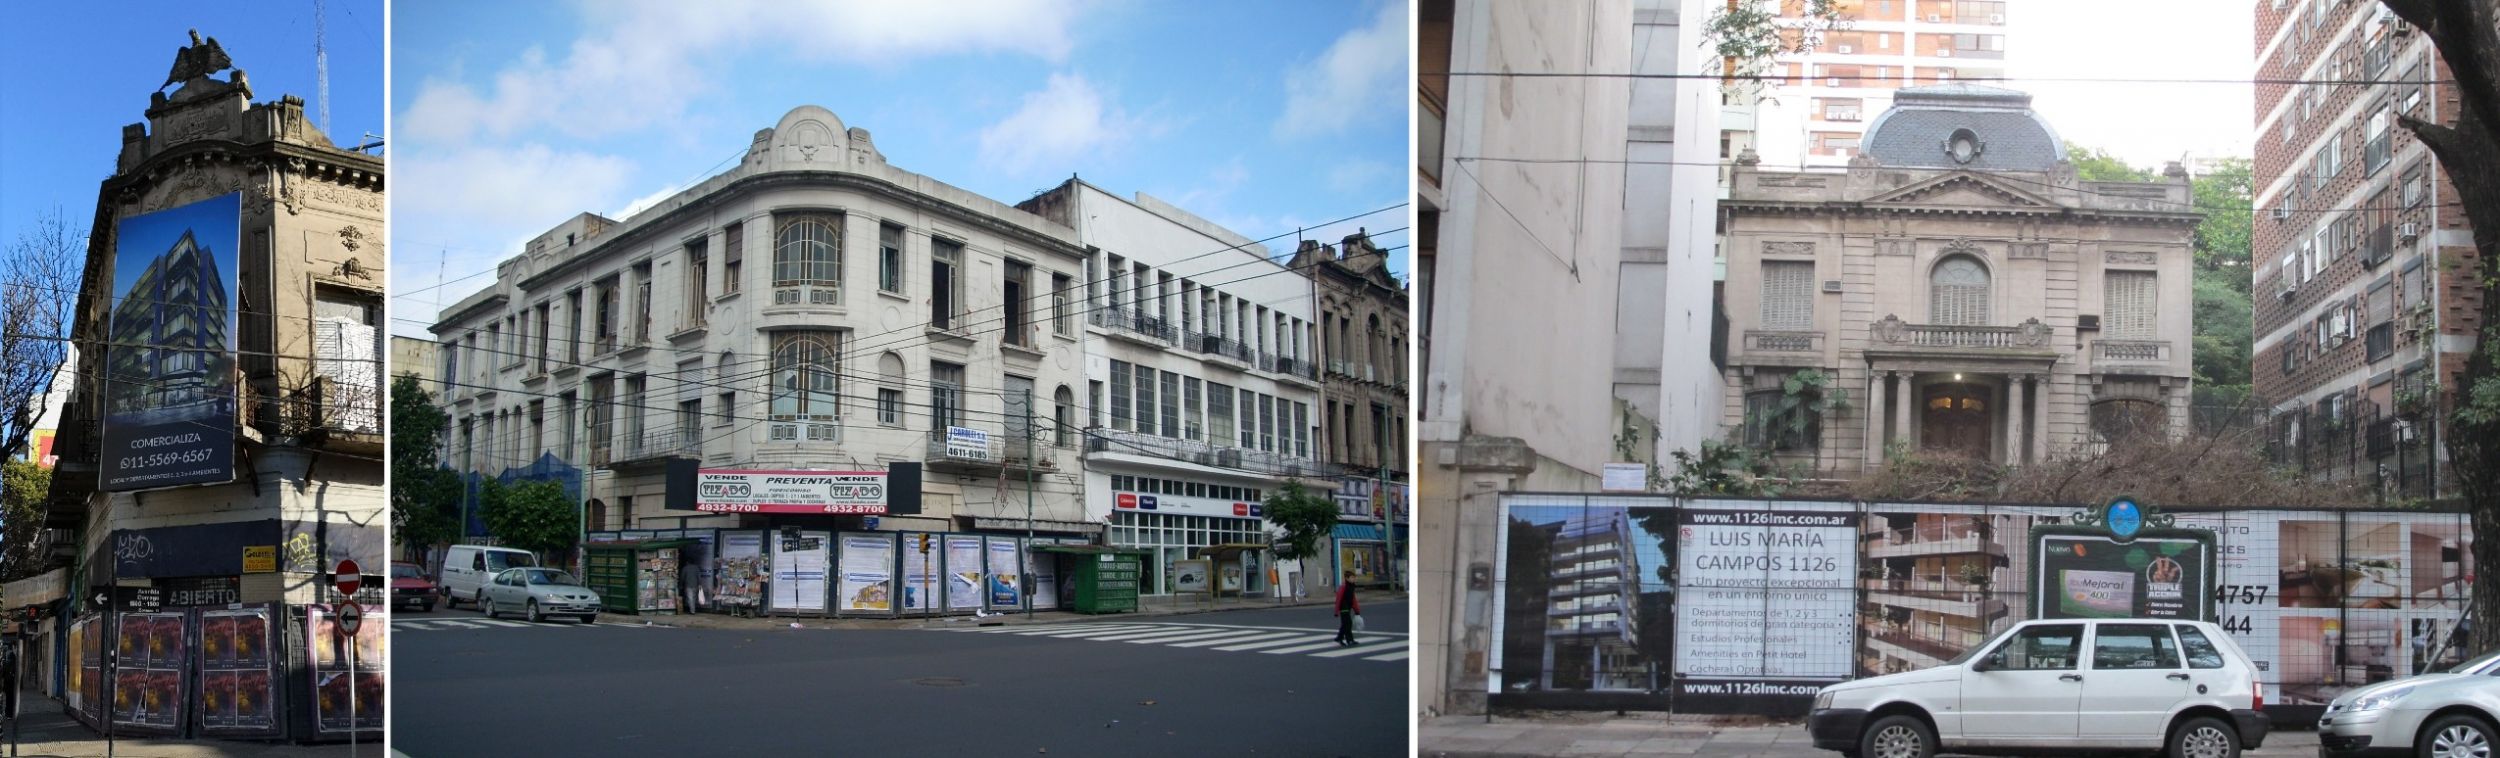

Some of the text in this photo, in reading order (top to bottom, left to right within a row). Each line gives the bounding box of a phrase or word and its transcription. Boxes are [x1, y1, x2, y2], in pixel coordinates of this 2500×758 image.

[131, 433, 201, 449] COMERCIALIZA
[131, 448, 213, 469] 11-5569-6567
[948, 448, 987, 459] 4611-6185
[704, 484, 749, 496] TIZADO
[834, 486, 880, 497] TIZADO
[698, 504, 759, 512] 4932-8700
[1693, 512, 1847, 525] www.1126lmc.com.ar
[1710, 529, 1824, 548] LUIS MARÍA
[1696, 555, 1836, 572] CAMPOS 1126
[1696, 577, 1841, 588] Un proyecto excepcional
[170, 589, 236, 605] ABIERTO
[1708, 591, 1723, 600] en
[1726, 591, 1742, 600] un
[1744, 591, 1792, 600] entorno
[2090, 592, 2110, 600] 400
[2215, 584, 2268, 604] 4757
[1692, 608, 1766, 618] Departamentos
[1770, 608, 1782, 617] de
[1796, 608, 1801, 617] 2
[1811, 608, 1818, 618] 3
[1691, 619, 1748, 628] dormitorios
[1750, 619, 1762, 628] de
[1765, 621, 1788, 630] gran
[1690, 634, 1798, 644] Estudios Profesonales
[1690, 650, 1738, 658] Amenities
[1756, 650, 1778, 659] Petit
[1780, 651, 1807, 659] Hotel
[1689, 665, 1783, 674] Cocheras Optatvas
